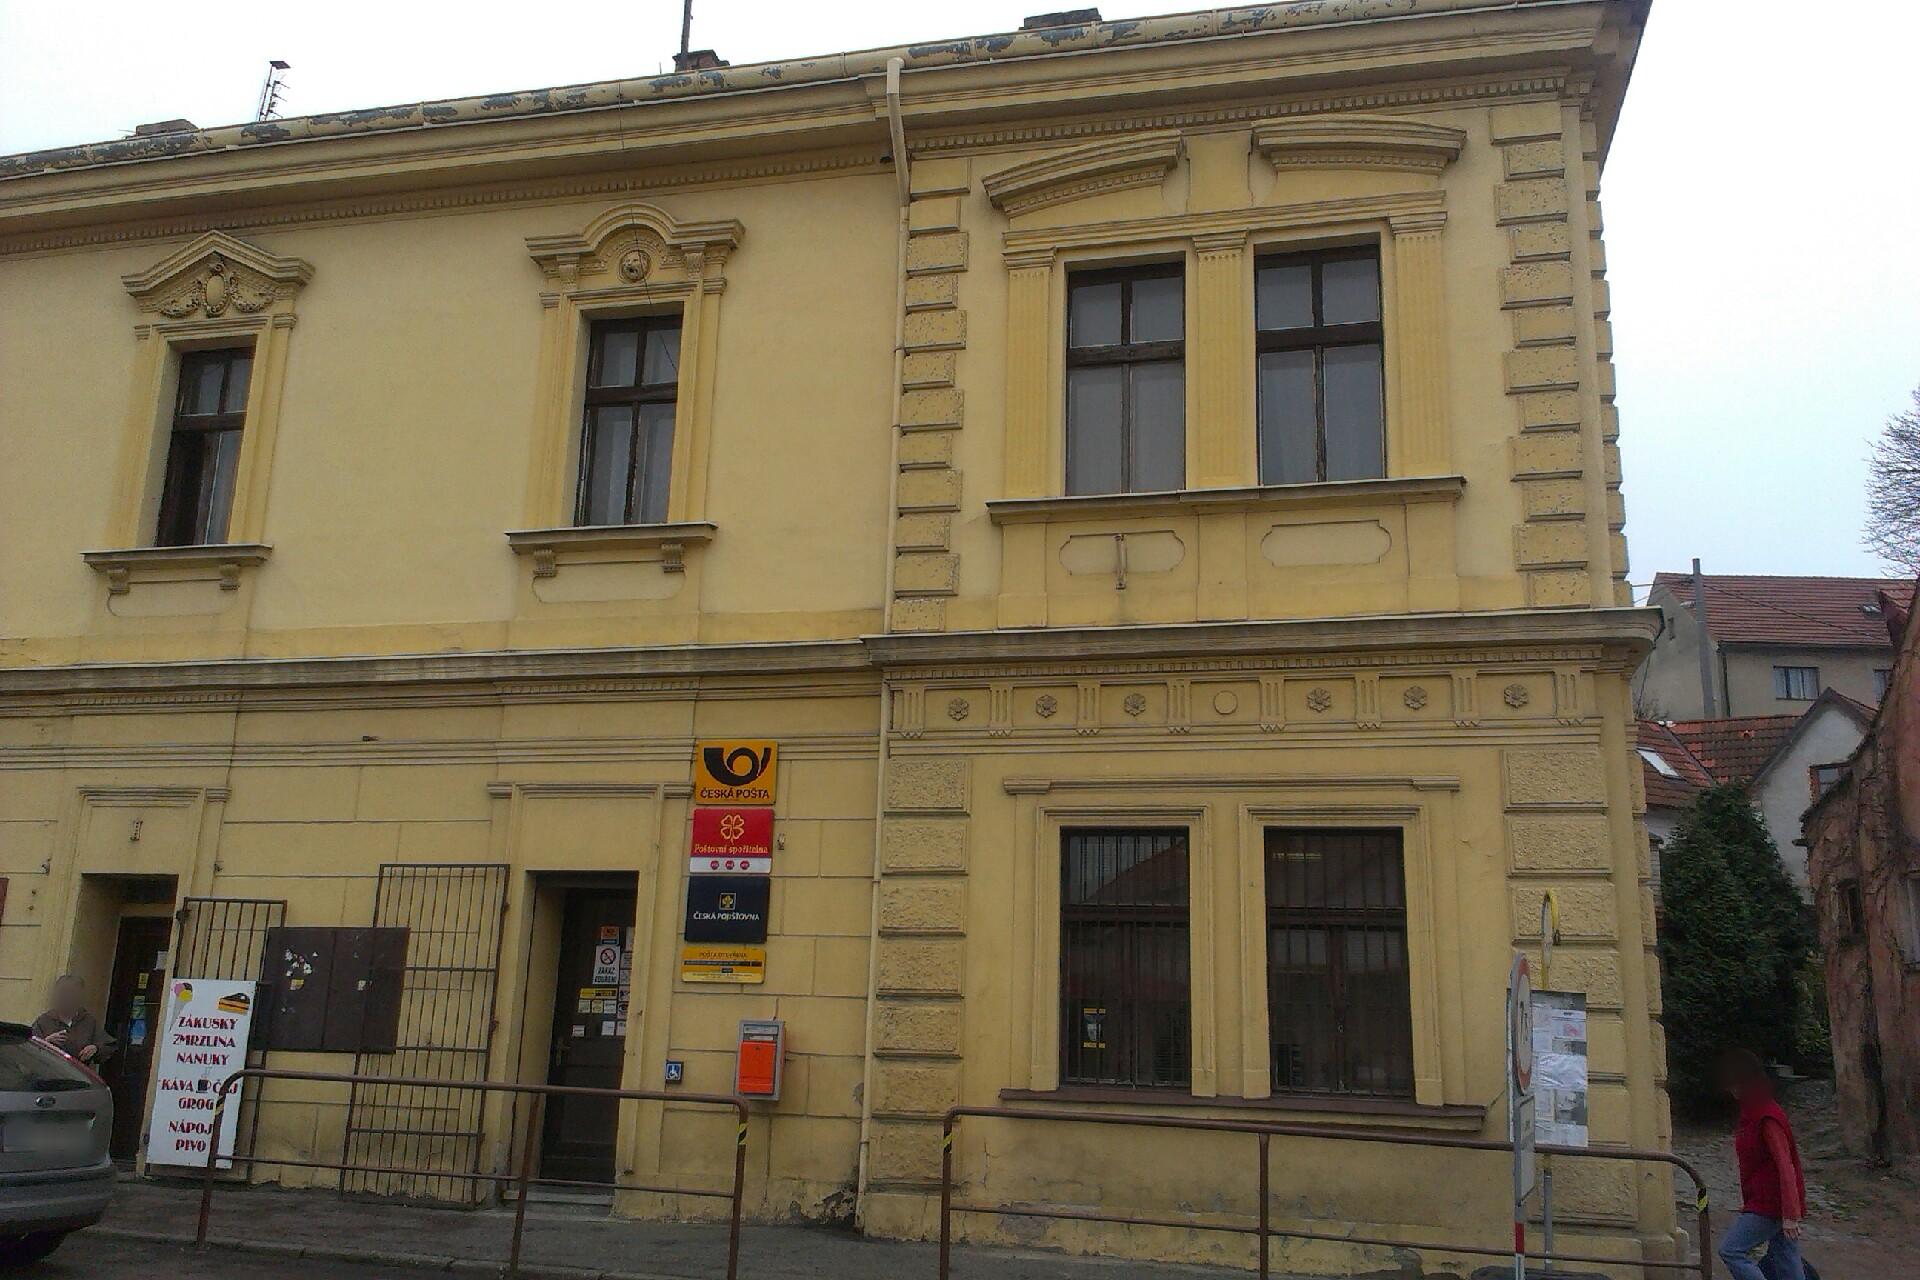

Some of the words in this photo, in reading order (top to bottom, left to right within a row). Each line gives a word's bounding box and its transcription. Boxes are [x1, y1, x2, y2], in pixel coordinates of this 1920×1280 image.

[700, 787, 733, 799] ČESKÁ
[736, 787, 769, 798] POŠTA
[694, 843, 726, 854] Poštovní
[729, 844, 768, 854] spořitelna
[693, 911, 716, 920] ČESKÁ
[178, 1015, 237, 1030] ZÁKUSKY
[173, 1034, 236, 1048] ZMRZLINA
[177, 1053, 229, 1066] NANUKY
[161, 1077, 194, 1091] KÁVA
[213, 1079, 238, 1094] ČJ
[178, 1098, 214, 1111] GROG
[175, 1139, 207, 1153] PIVO
